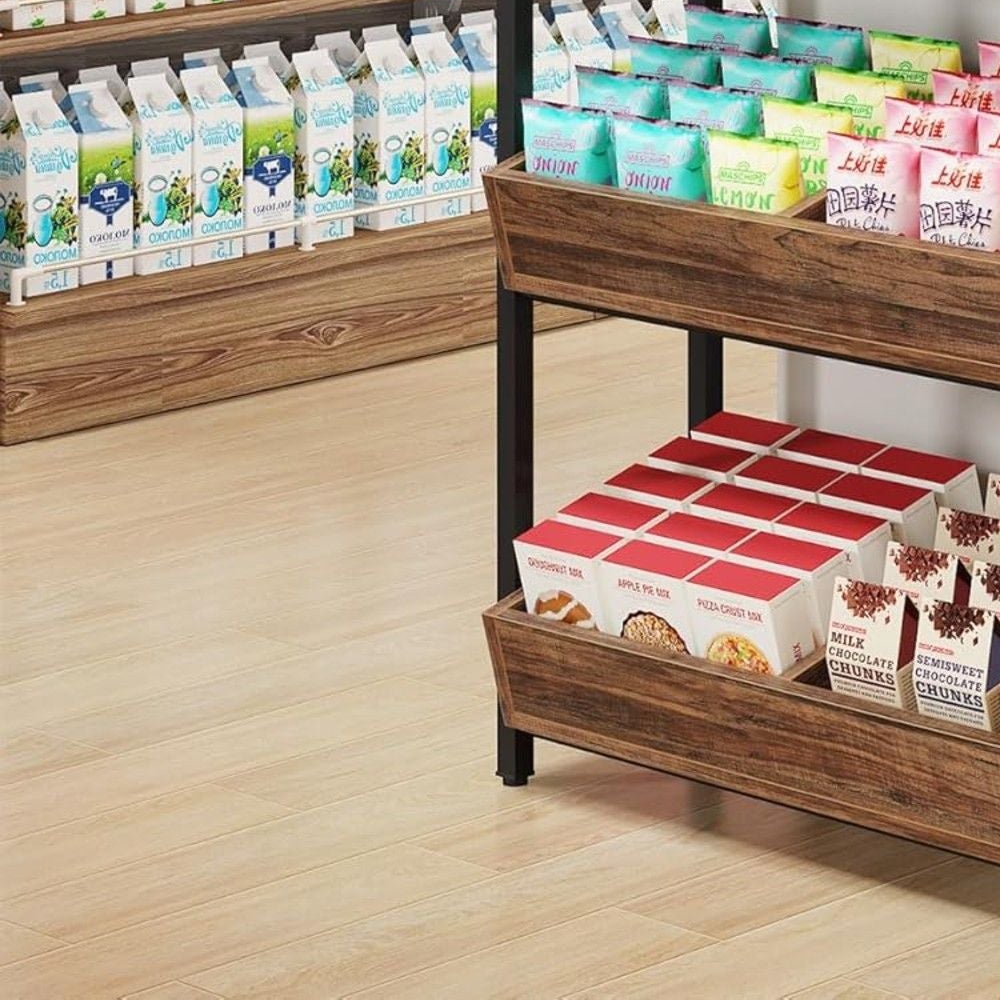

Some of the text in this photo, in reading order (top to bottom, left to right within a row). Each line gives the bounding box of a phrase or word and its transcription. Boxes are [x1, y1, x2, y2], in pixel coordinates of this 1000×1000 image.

[950, 87, 996, 112] 上好佳
[894, 114, 946, 139] 上好佳
[837, 150, 889, 175] 上好佳
[930, 164, 984, 190] 上好佳
[617, 578, 641, 592] APPLE
[830, 631, 865, 650] MILK
[829, 646, 894, 670] CHOCOLATE
[916, 653, 985, 679] SEMISWEET
[829, 659, 895, 686] CHUNKS
[915, 667, 982, 692] CHOCOLATE
[915, 680, 983, 708] CHUNKS
